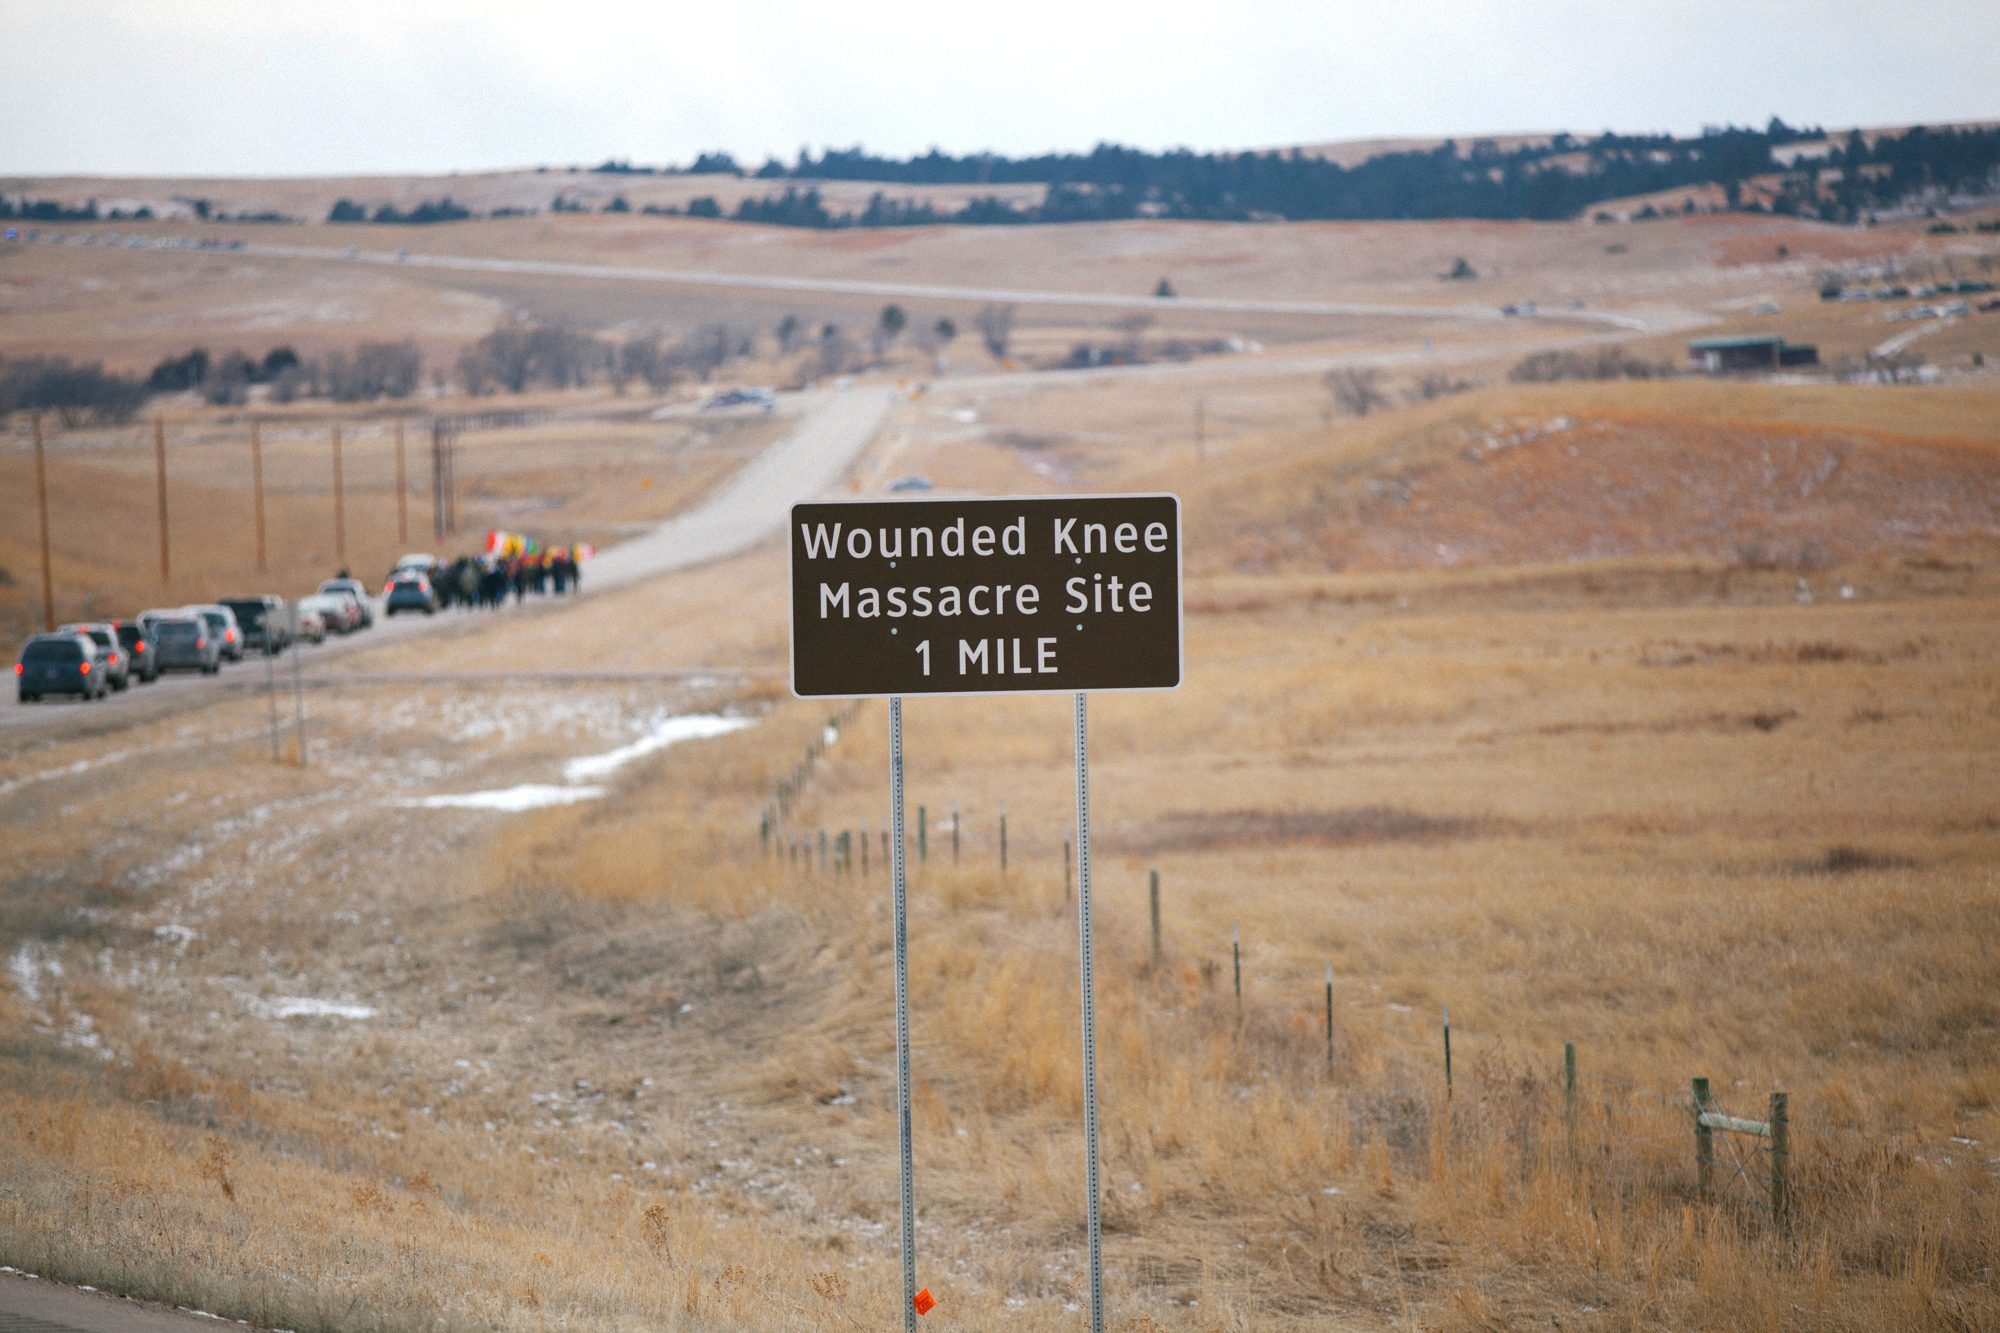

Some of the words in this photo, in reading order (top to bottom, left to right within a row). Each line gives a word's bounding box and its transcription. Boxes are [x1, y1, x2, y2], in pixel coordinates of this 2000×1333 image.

[801, 516, 1026, 560] Wounded
[1054, 518, 1168, 555] Knee
[820, 582, 1040, 619] Massacre
[1065, 573, 1153, 614] Site
[915, 639, 931, 676] 1
[958, 637, 1058, 675] MILE
